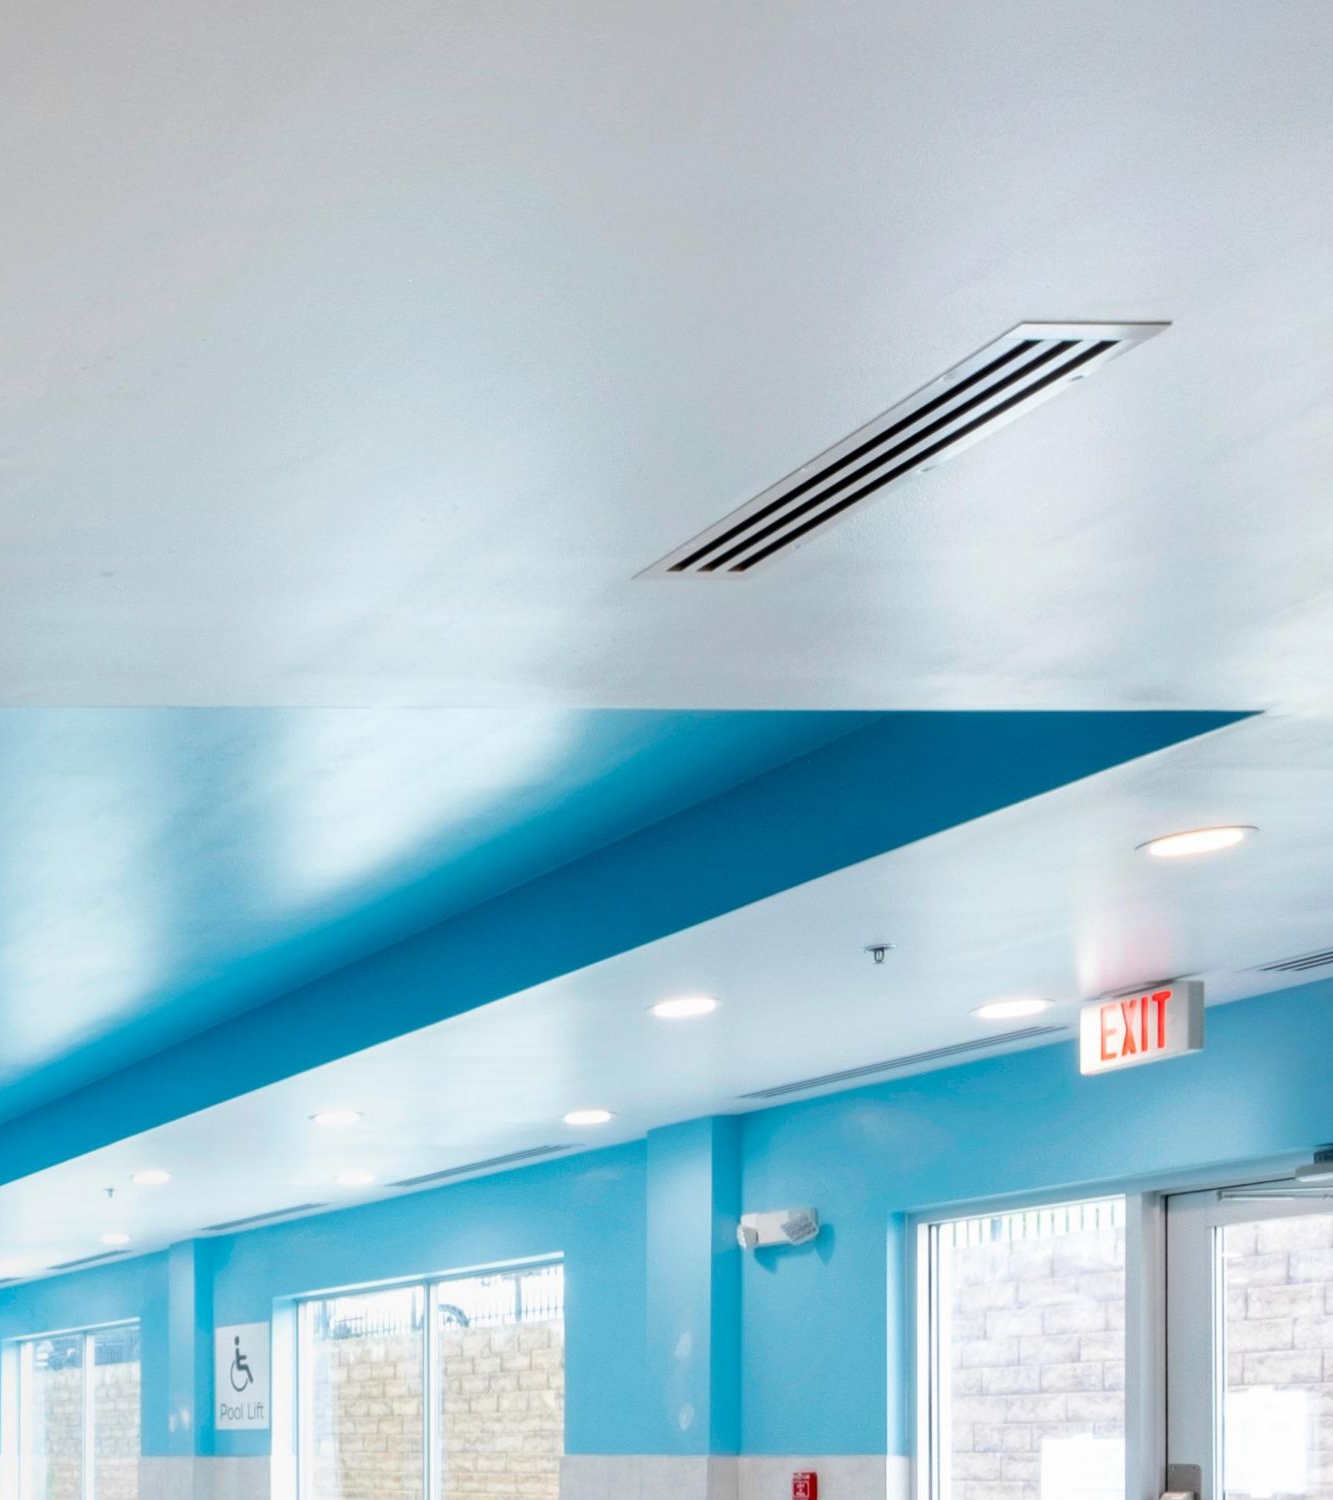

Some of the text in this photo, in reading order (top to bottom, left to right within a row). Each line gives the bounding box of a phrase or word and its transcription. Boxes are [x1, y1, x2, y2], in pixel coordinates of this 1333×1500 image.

[1100, 990, 1173, 1061] EXIT
[220, 1401, 264, 1421] Pool Lift
